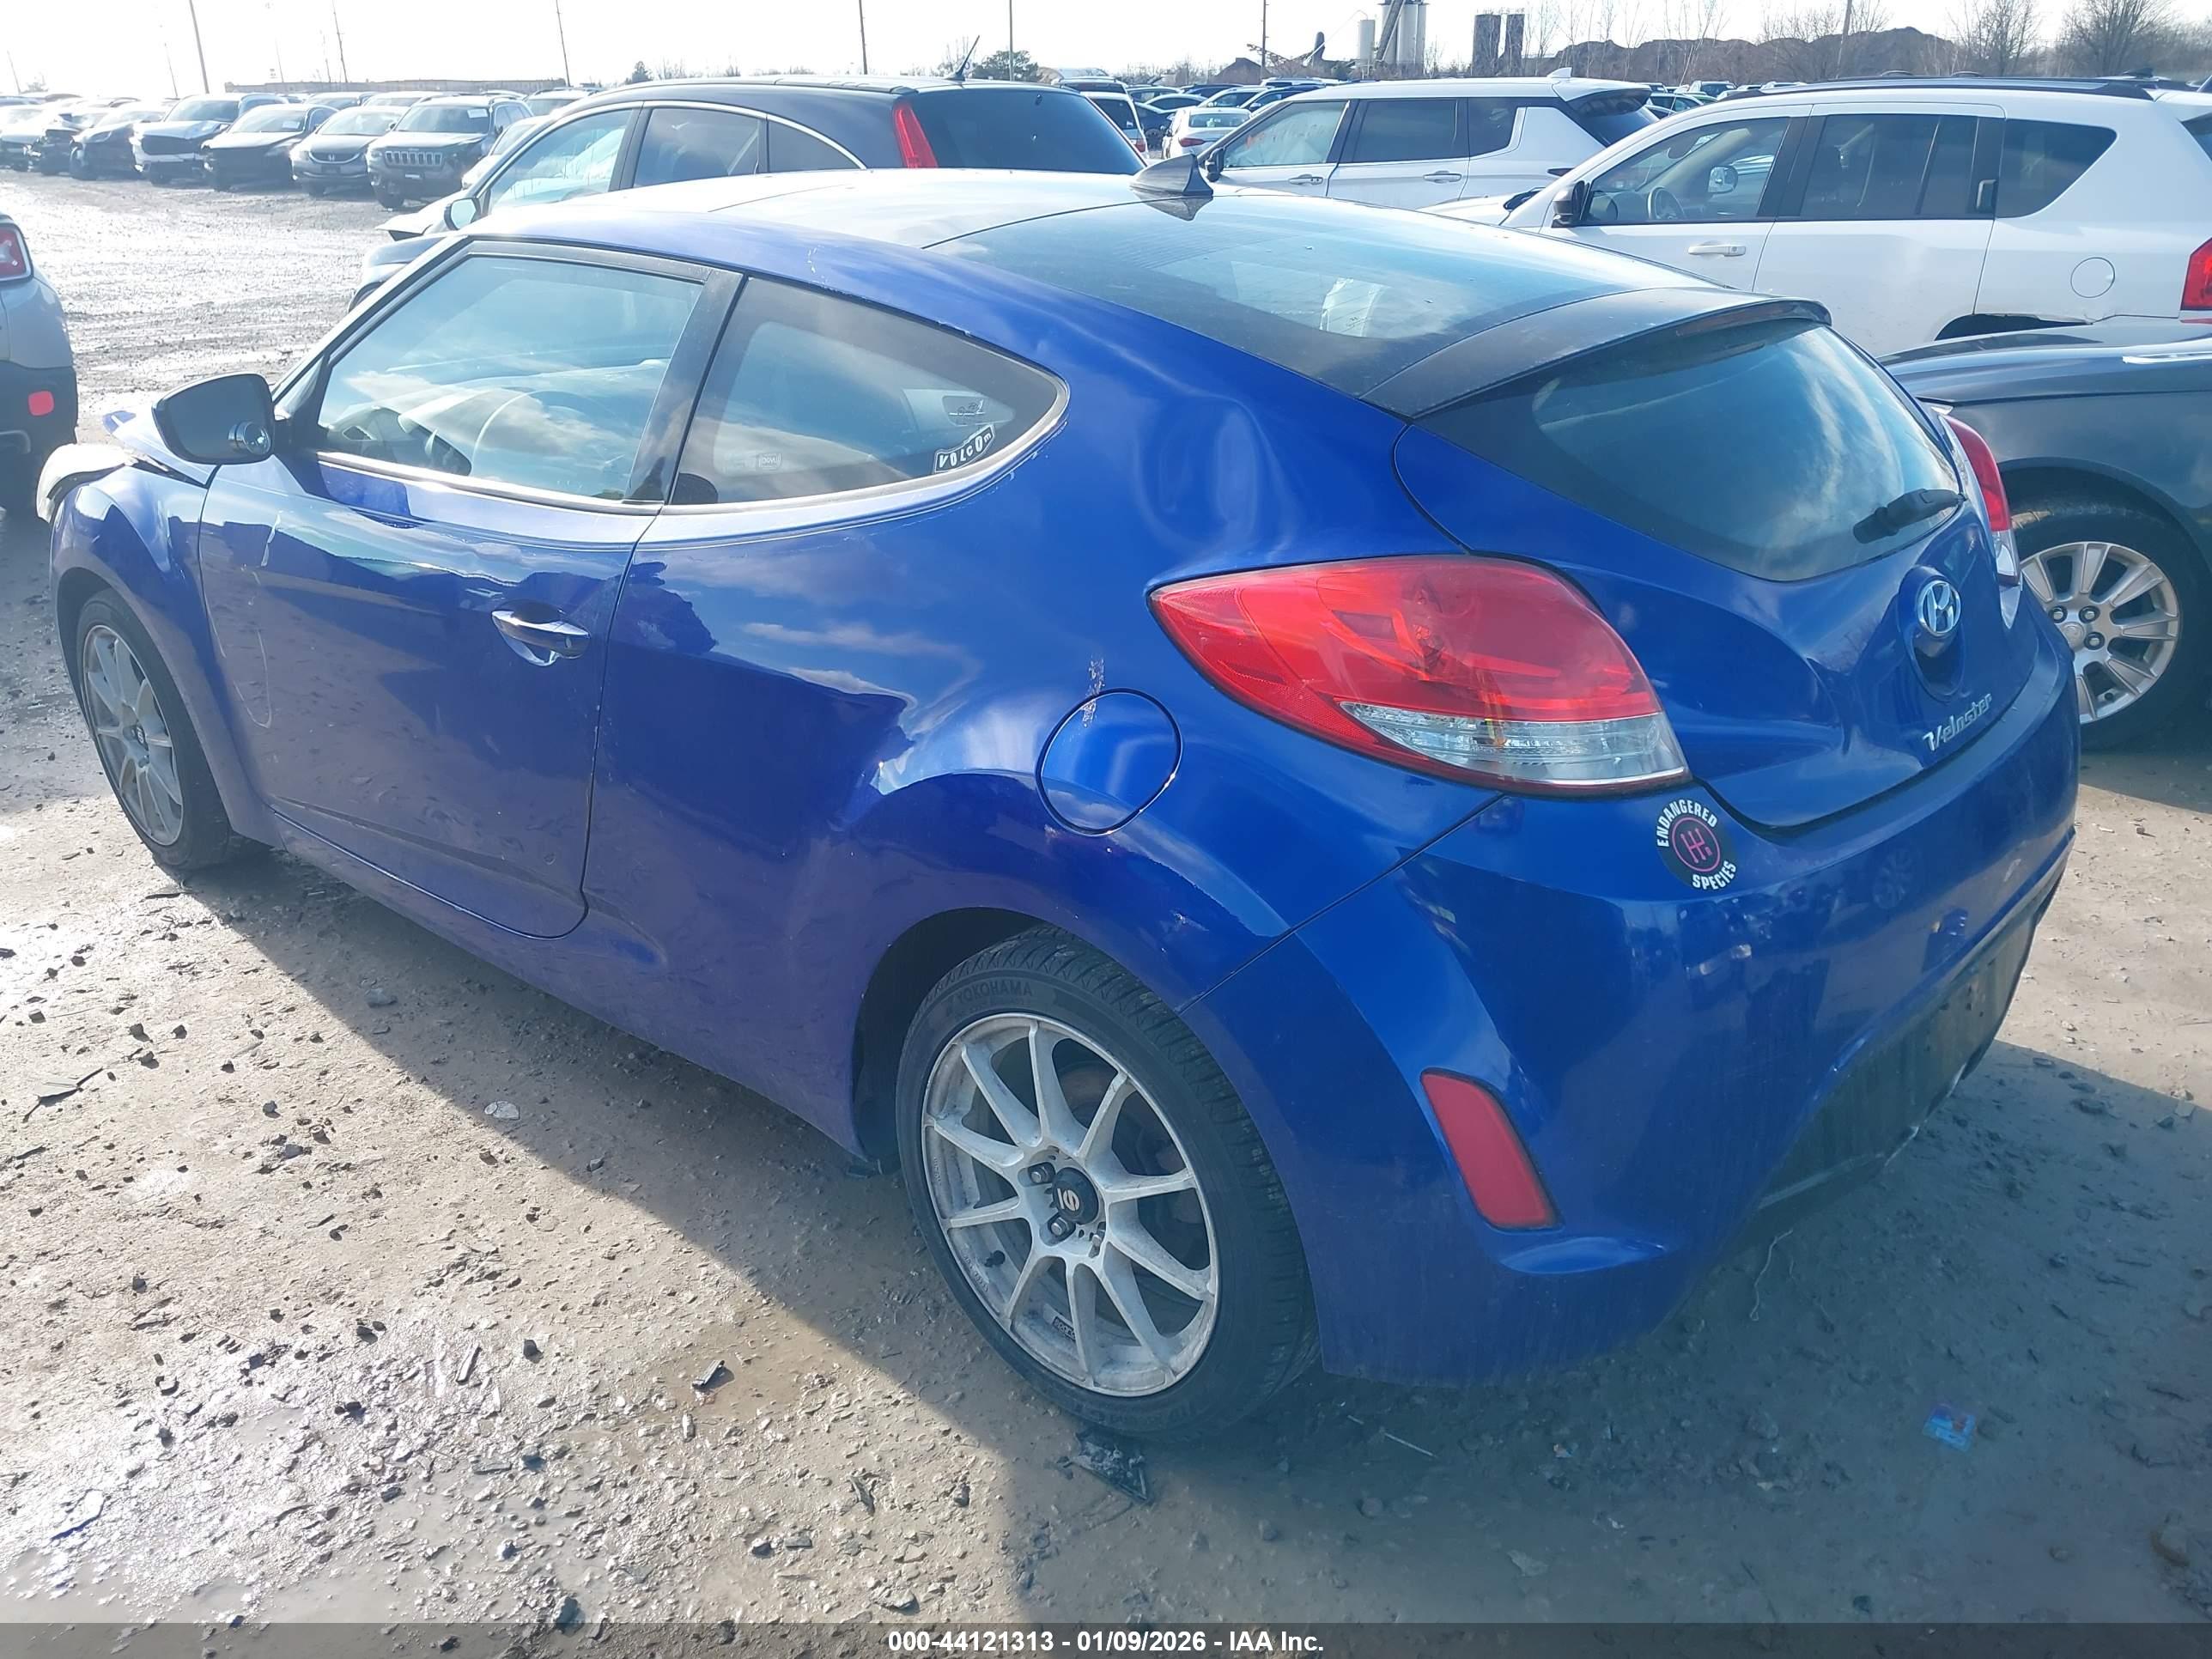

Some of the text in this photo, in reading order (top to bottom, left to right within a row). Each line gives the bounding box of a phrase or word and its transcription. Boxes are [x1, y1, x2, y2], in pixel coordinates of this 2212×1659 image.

[1656, 799, 1718, 848] ENDANGERED
[1692, 860, 1737, 890] SPECIES
[957, 979, 1032, 1003] YOKOHAMA
